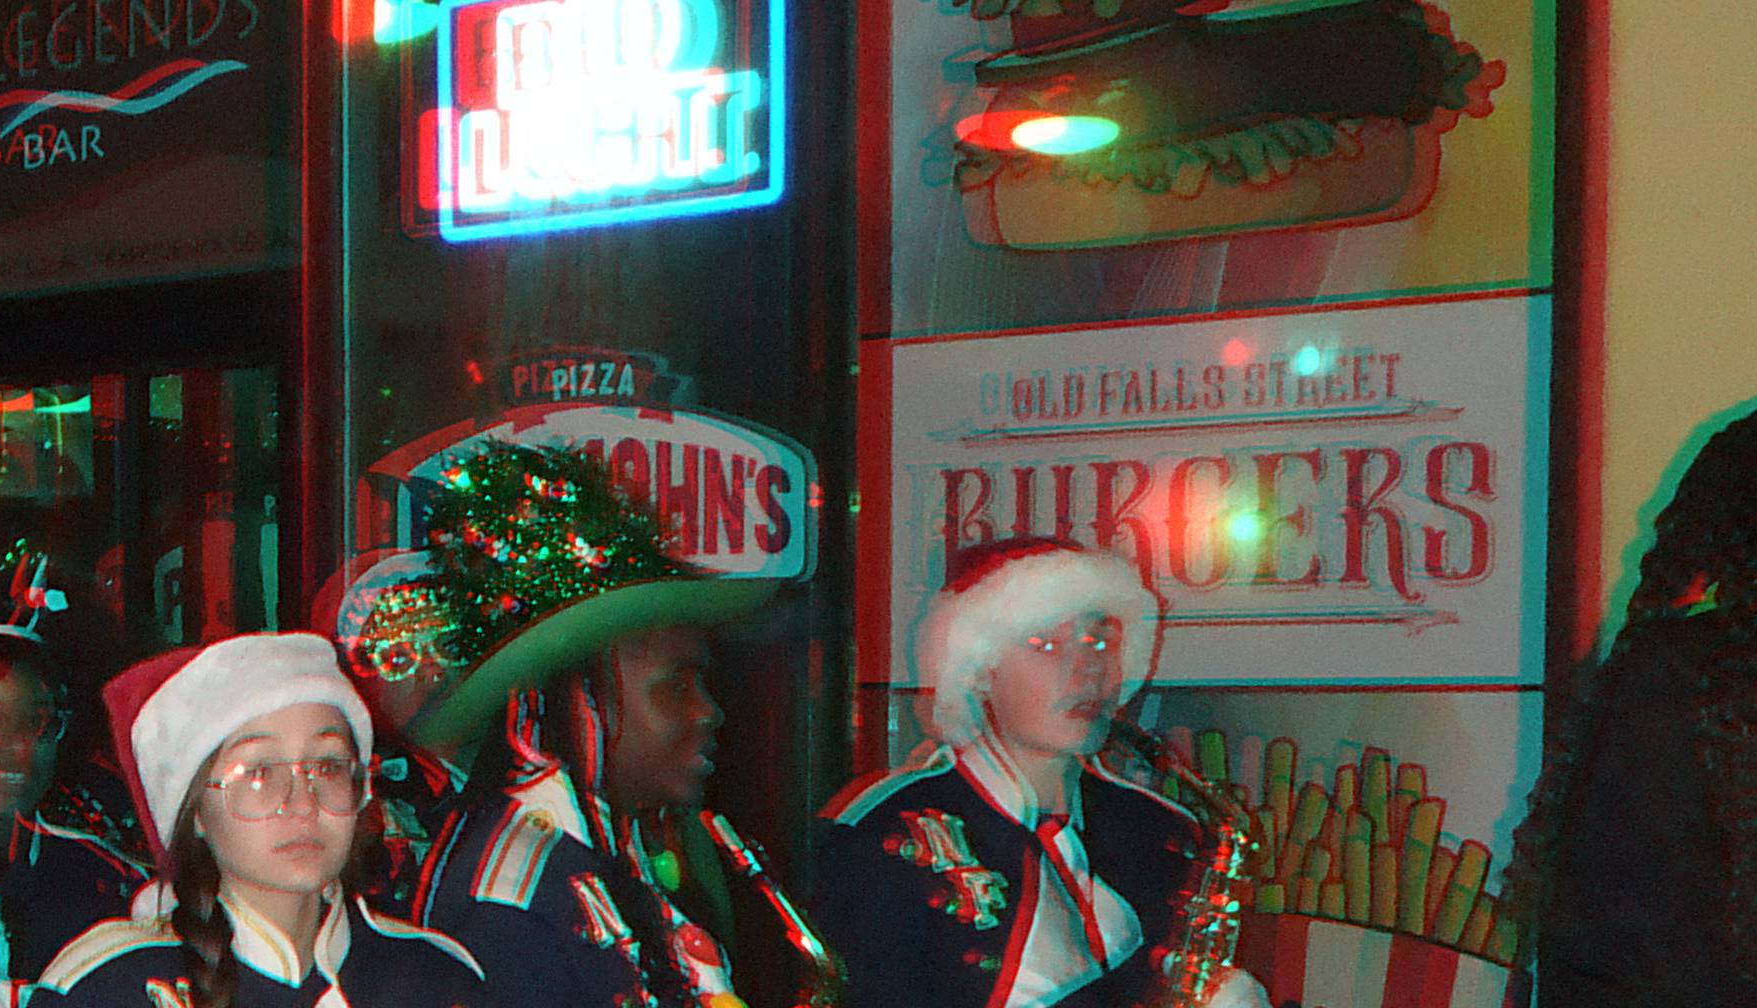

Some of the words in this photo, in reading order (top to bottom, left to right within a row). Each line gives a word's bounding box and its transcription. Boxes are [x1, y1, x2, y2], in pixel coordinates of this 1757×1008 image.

[22, 124, 104, 169] BAR
[550, 362, 636, 402] PIZZA
[1010, 374, 1084, 422] OLD
[1098, 360, 1226, 416] FALLS
[584, 436, 792, 556] OHN'S
[941, 440, 1498, 602] BURGERS
